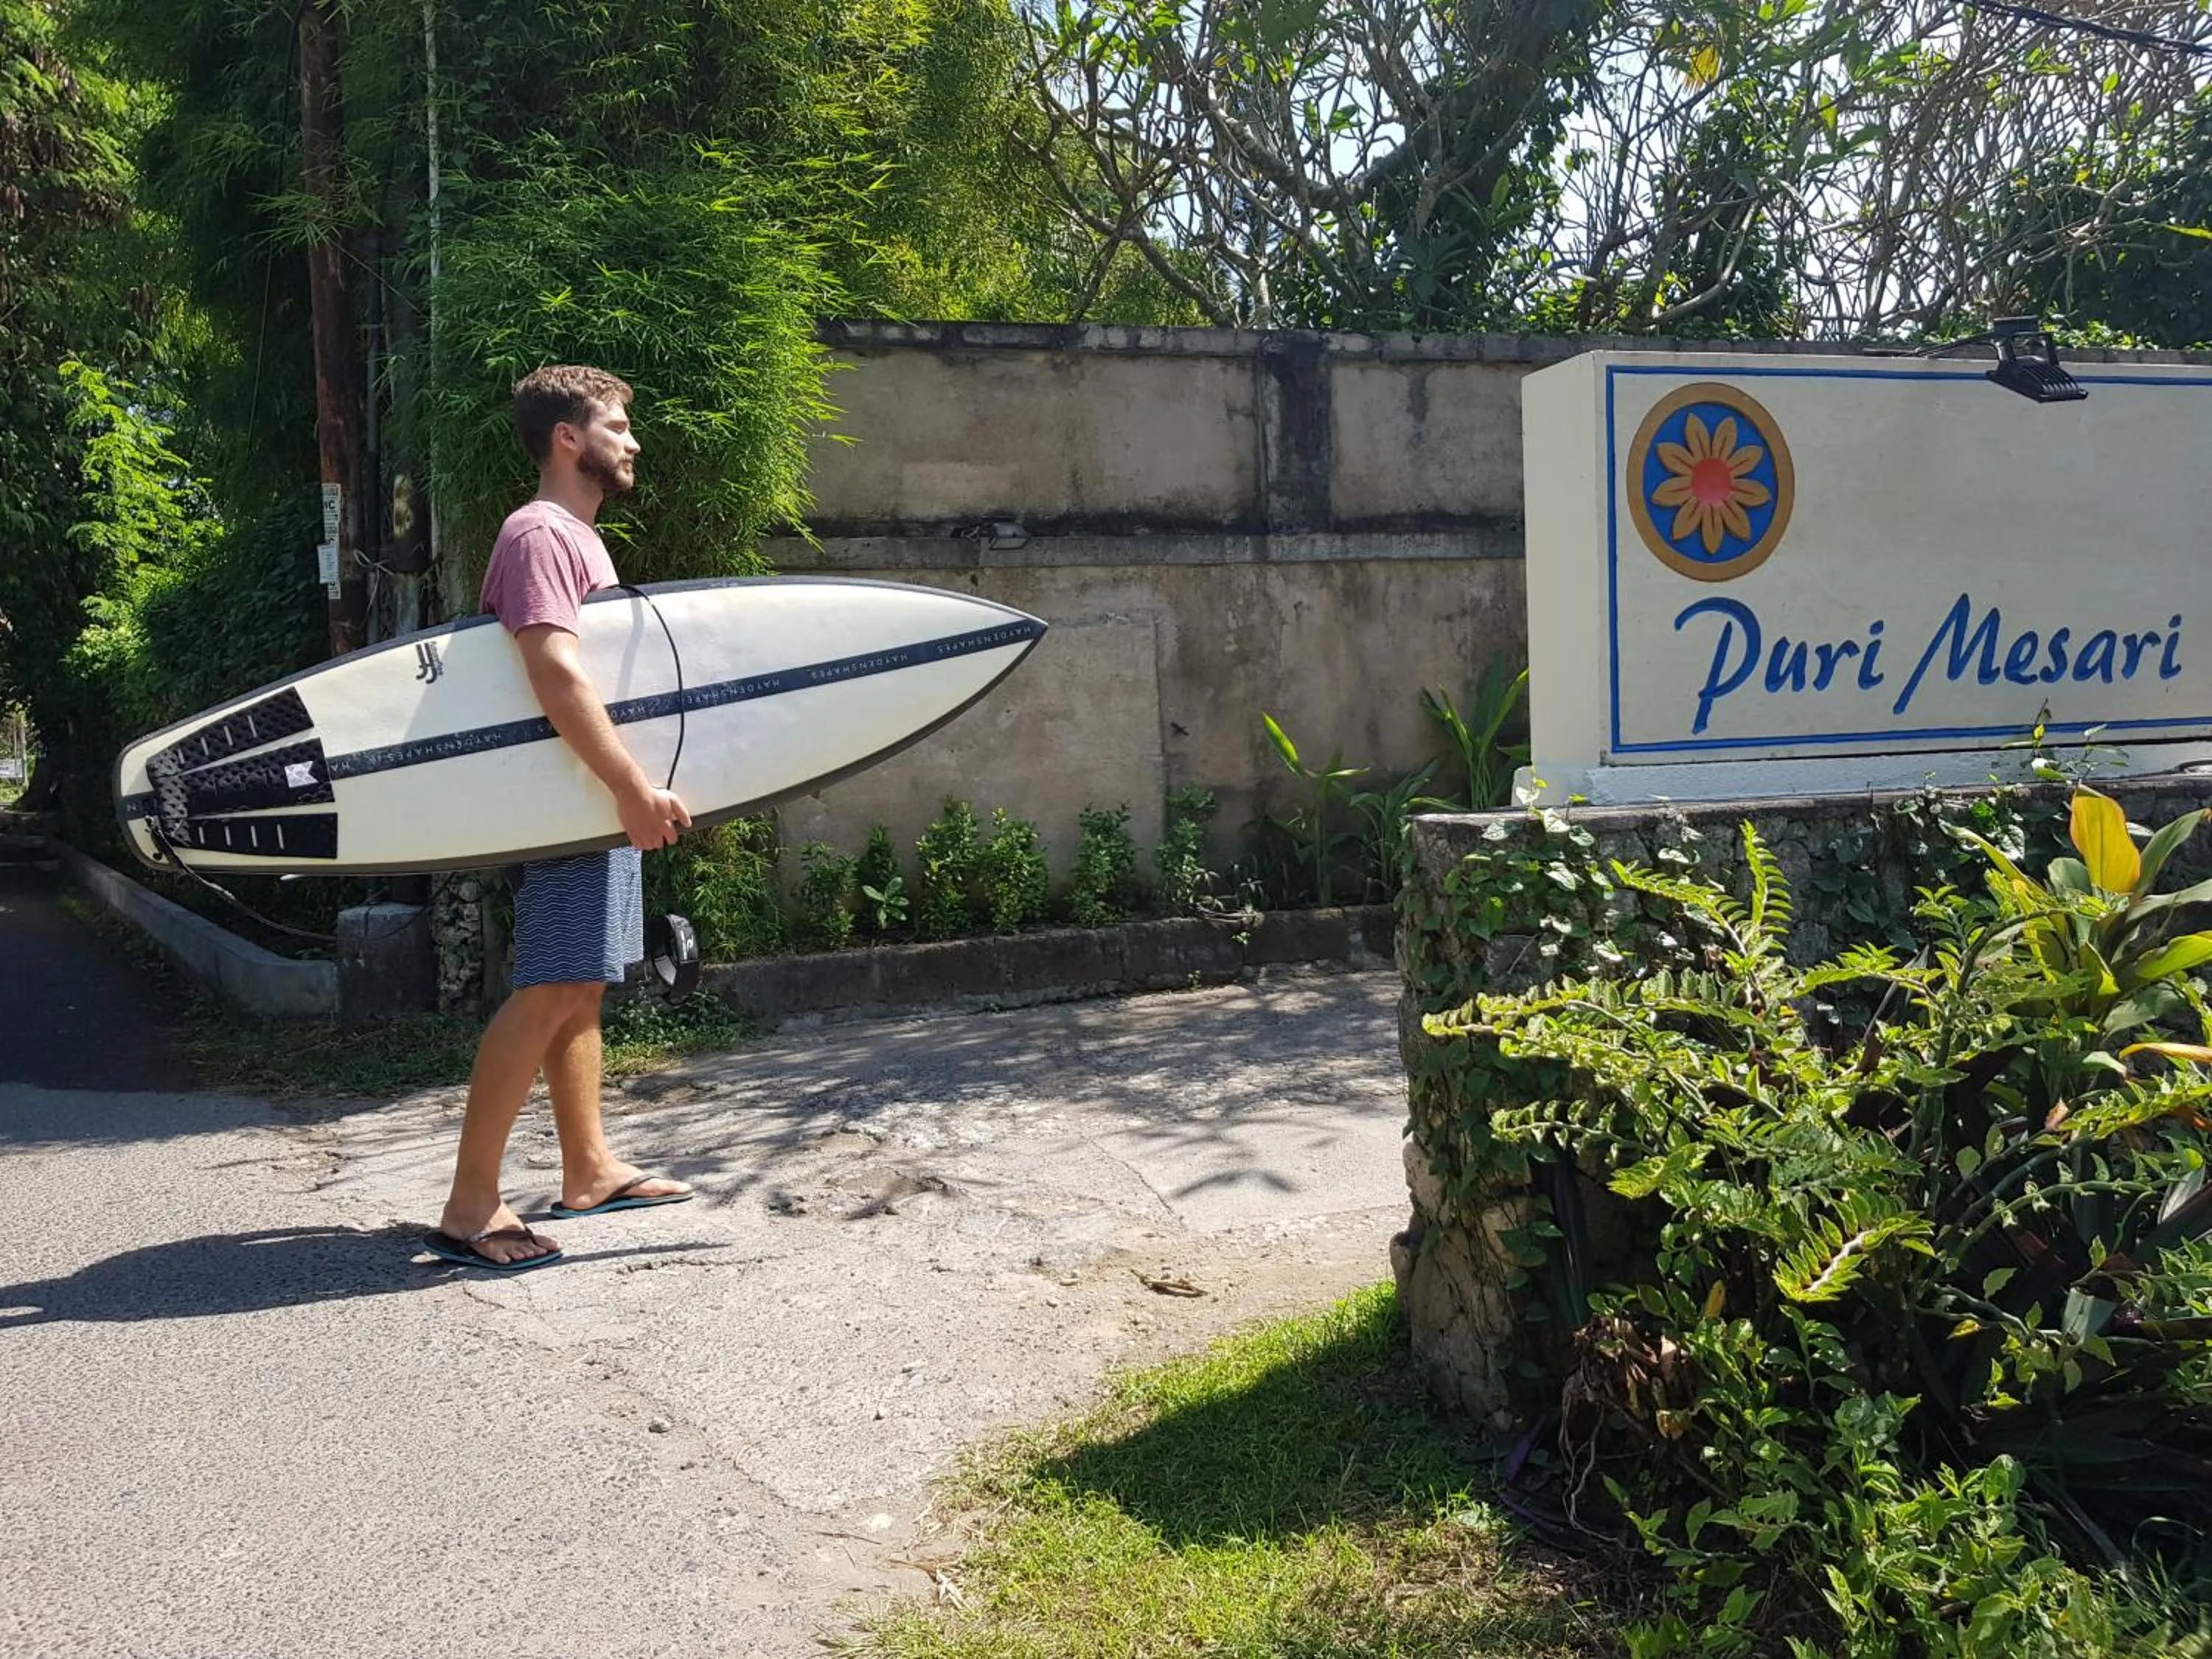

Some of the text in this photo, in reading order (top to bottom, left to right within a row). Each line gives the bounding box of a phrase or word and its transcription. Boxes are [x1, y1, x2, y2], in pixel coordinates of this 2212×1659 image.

[812, 653, 908, 678] HAYDENSHAPES
[1674, 593, 2183, 734] Puri Mesari
